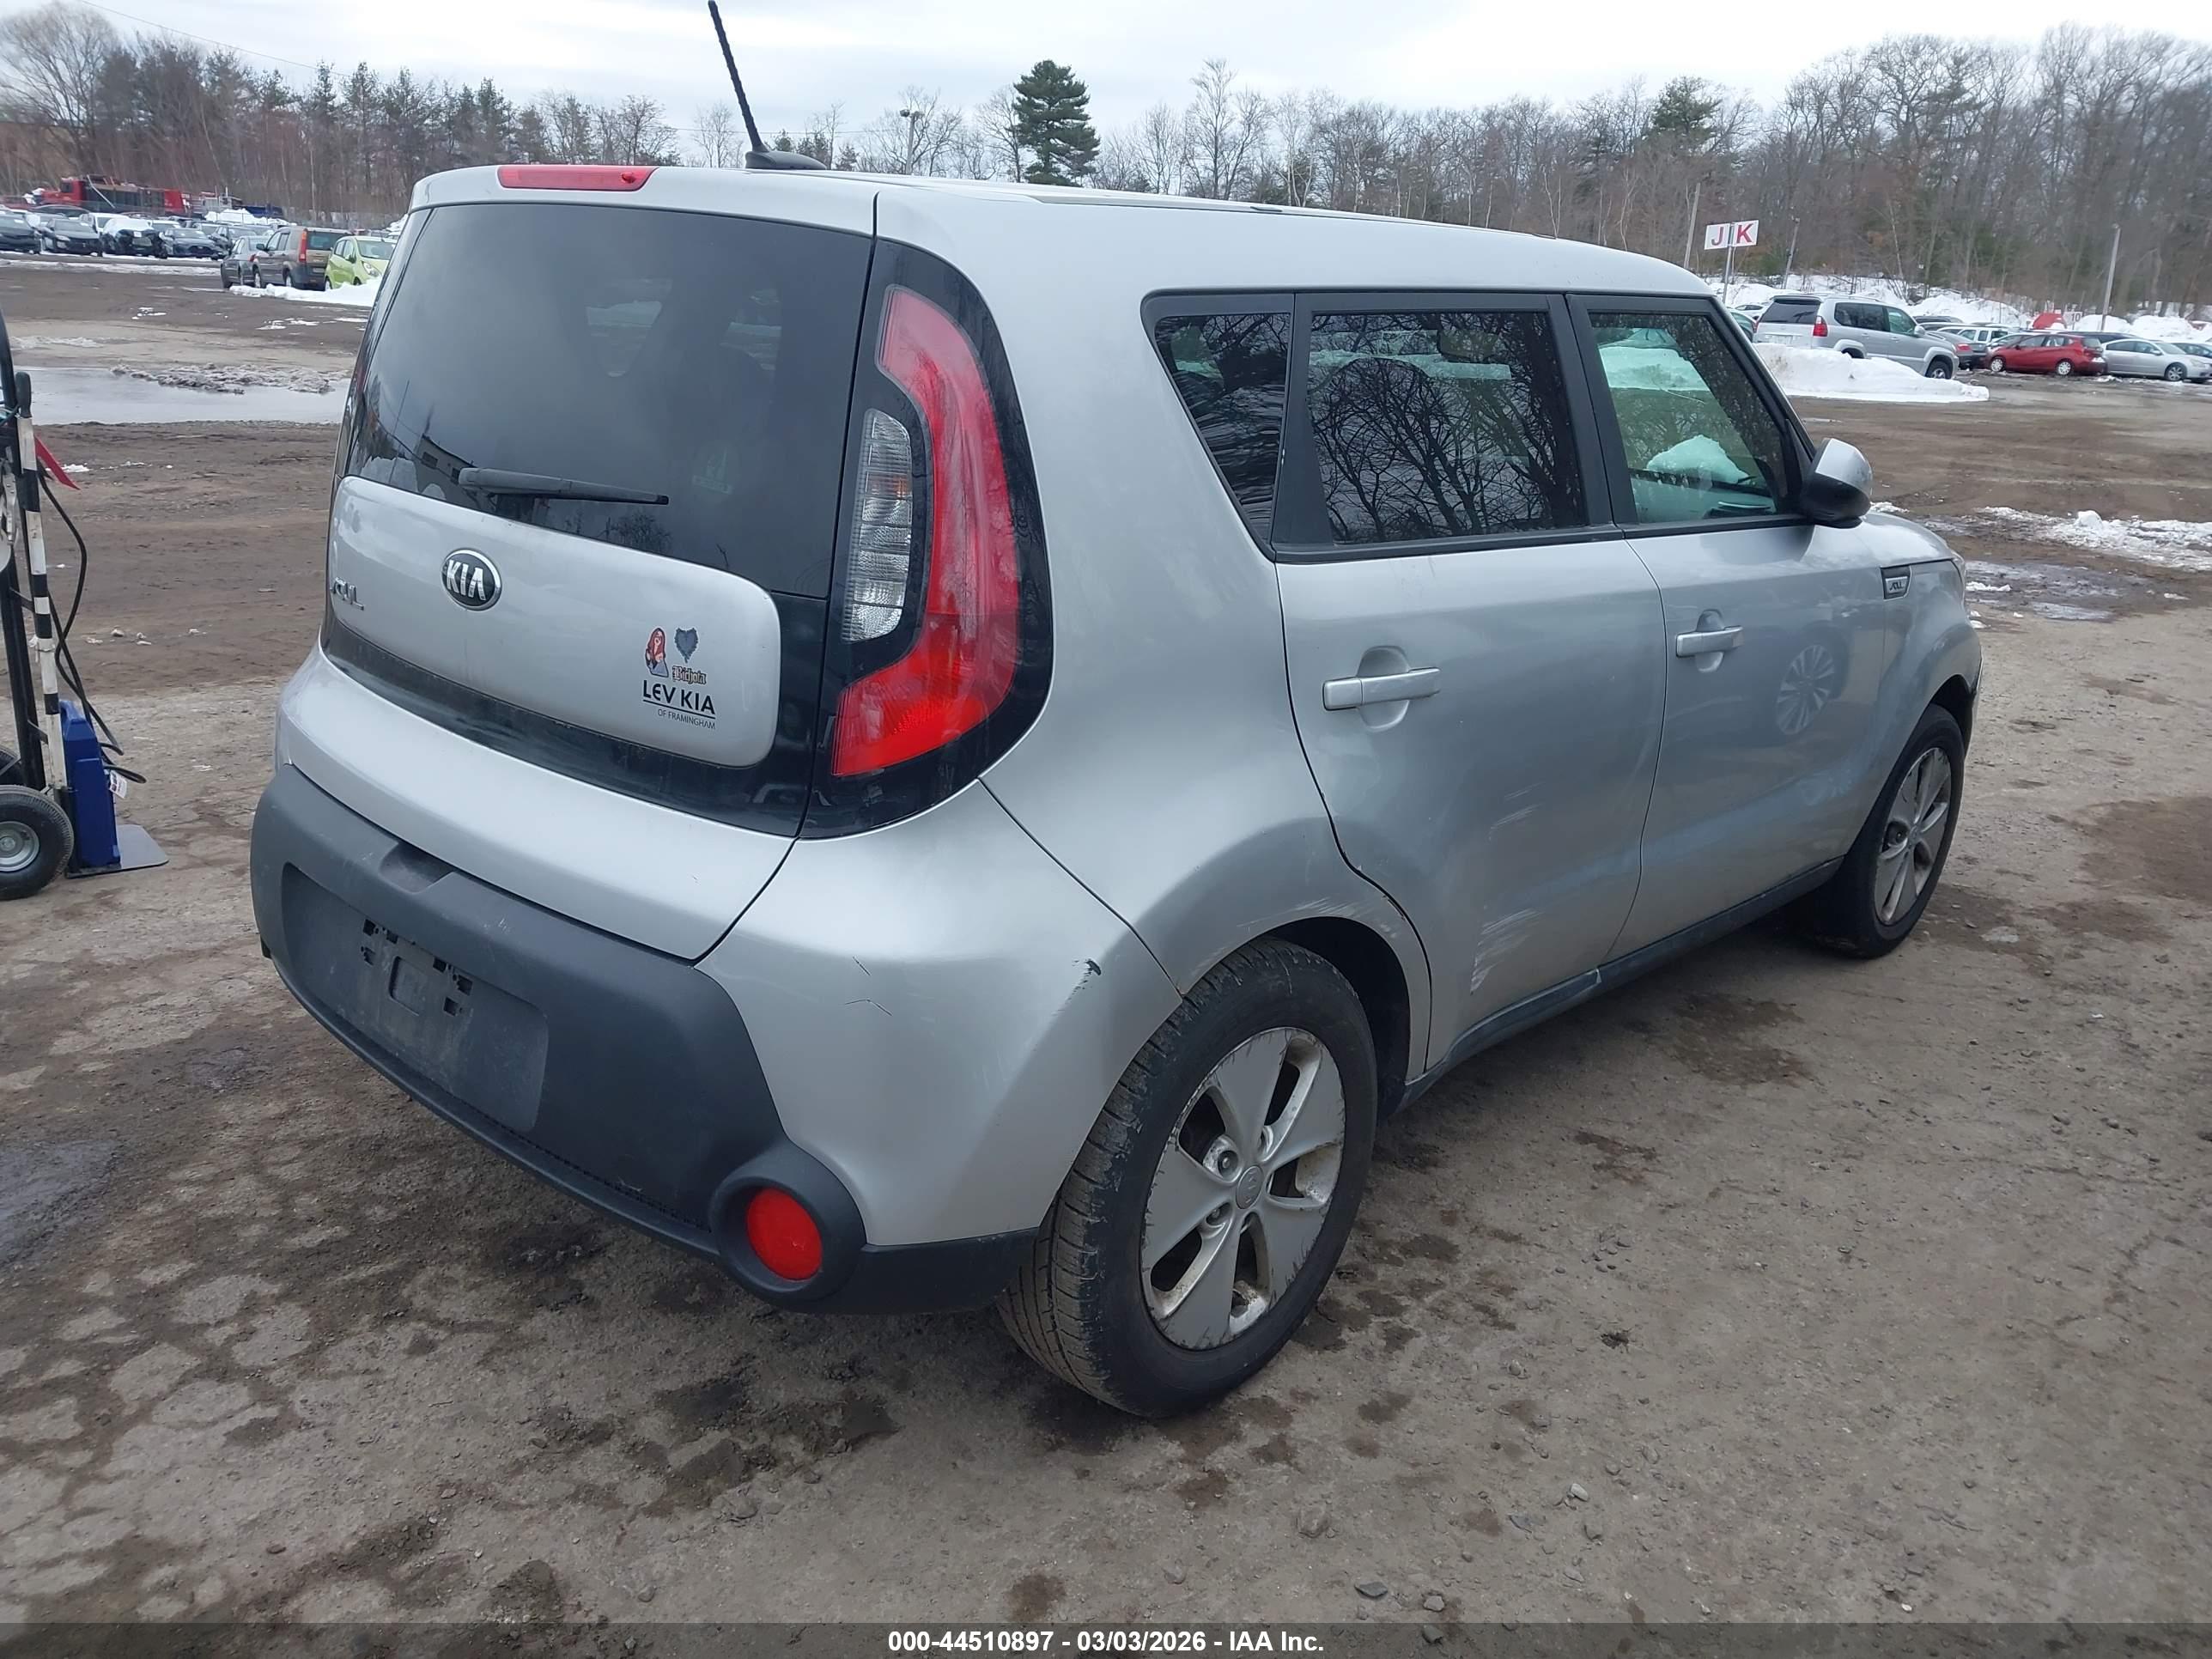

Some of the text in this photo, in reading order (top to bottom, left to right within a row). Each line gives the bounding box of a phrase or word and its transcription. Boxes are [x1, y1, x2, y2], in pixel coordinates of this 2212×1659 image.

[447, 559, 486, 601] KIA
[643, 680, 716, 714] LEV KIA
[658, 708, 716, 730] OF FRAMINGHAM
